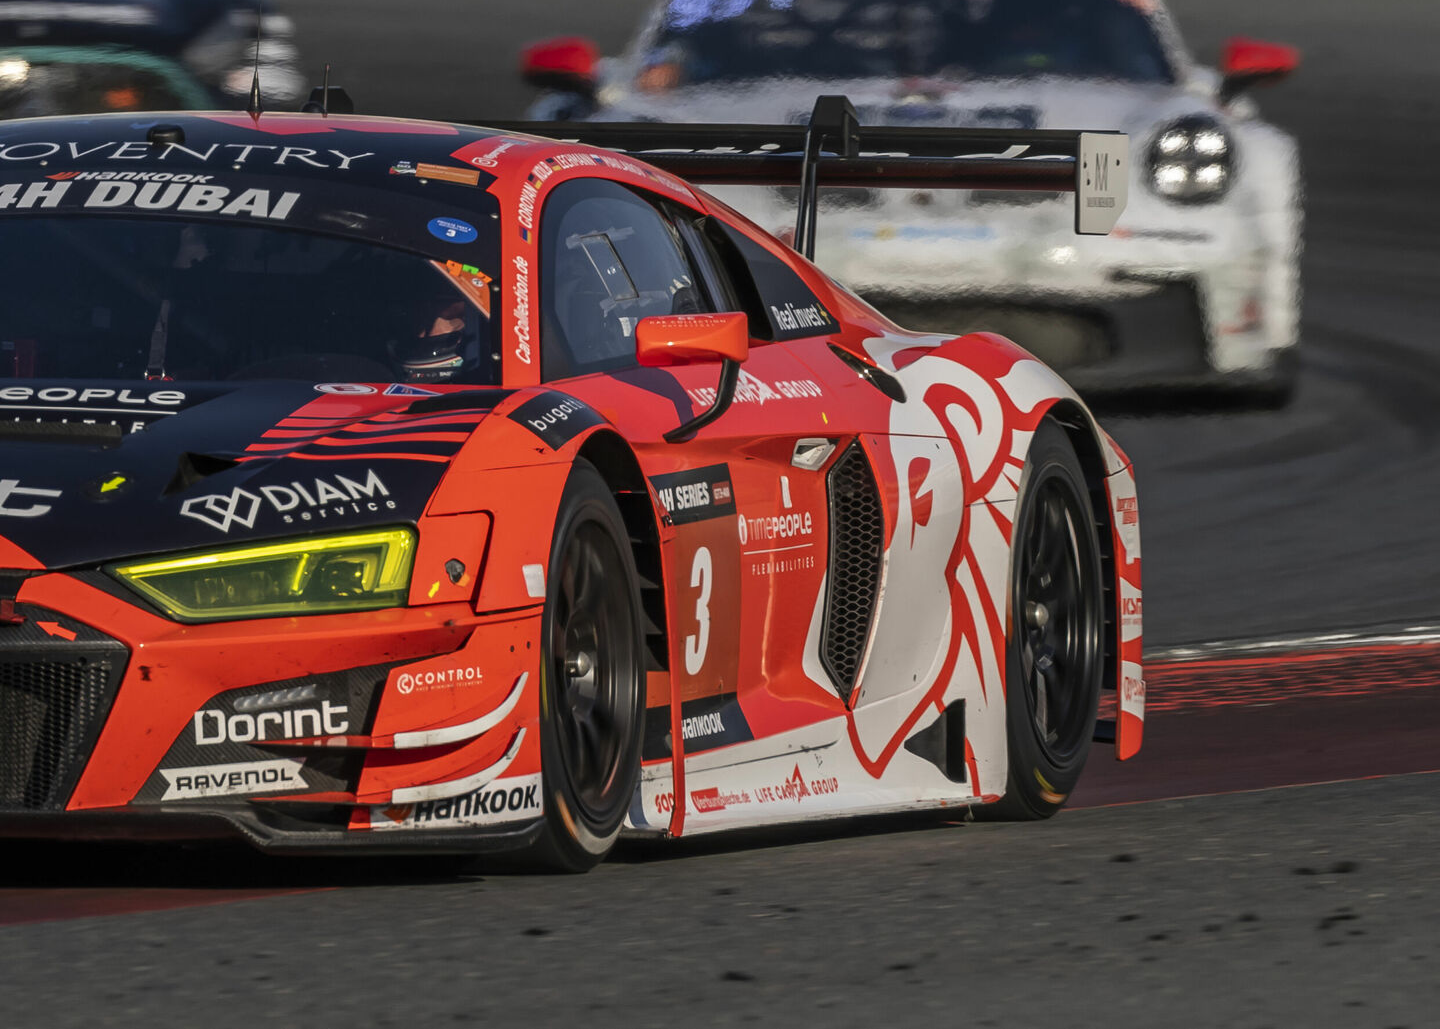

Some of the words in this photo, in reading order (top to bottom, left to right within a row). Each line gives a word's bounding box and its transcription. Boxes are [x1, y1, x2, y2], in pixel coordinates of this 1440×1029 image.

[83, 181, 301, 220] DUBAI
[775, 379, 823, 398] GROUP
[260, 468, 390, 512] DIAM
[675, 481, 710, 511] SERIES
[283, 500, 397, 523] service
[685, 546, 713, 676] 3
[415, 666, 483, 686] CONTROL
[194, 700, 349, 746] Dorint
[176, 768, 294, 792] RAVENOL
[754, 786, 773, 803] LIFE
[811, 776, 839, 796] GROUP
